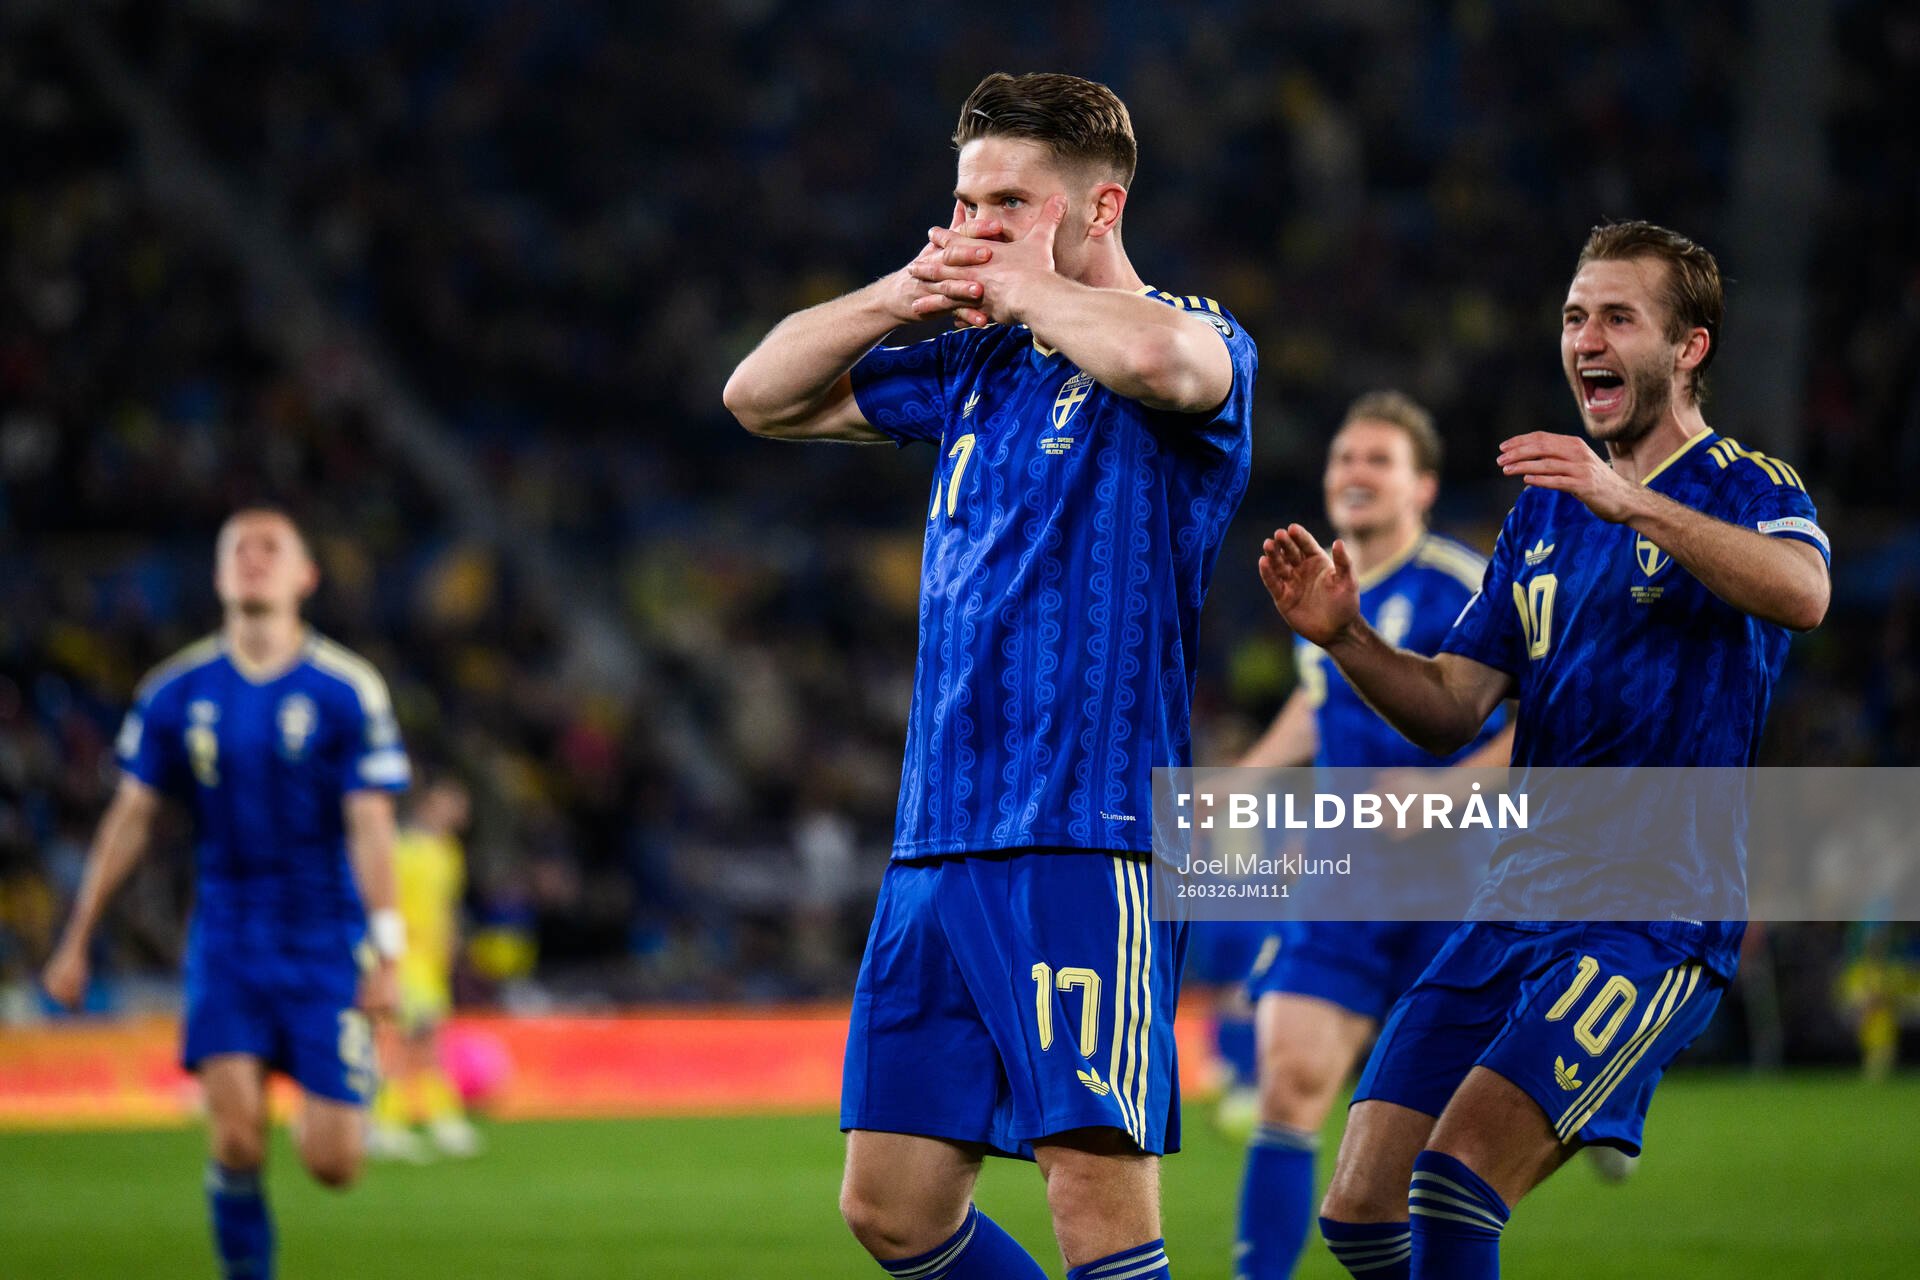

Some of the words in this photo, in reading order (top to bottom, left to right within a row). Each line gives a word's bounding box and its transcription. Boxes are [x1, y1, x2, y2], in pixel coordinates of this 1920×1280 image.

[1512, 573, 1558, 661] 10
[1032, 962, 1102, 1059] 17
[1545, 955, 1638, 1057] 10
